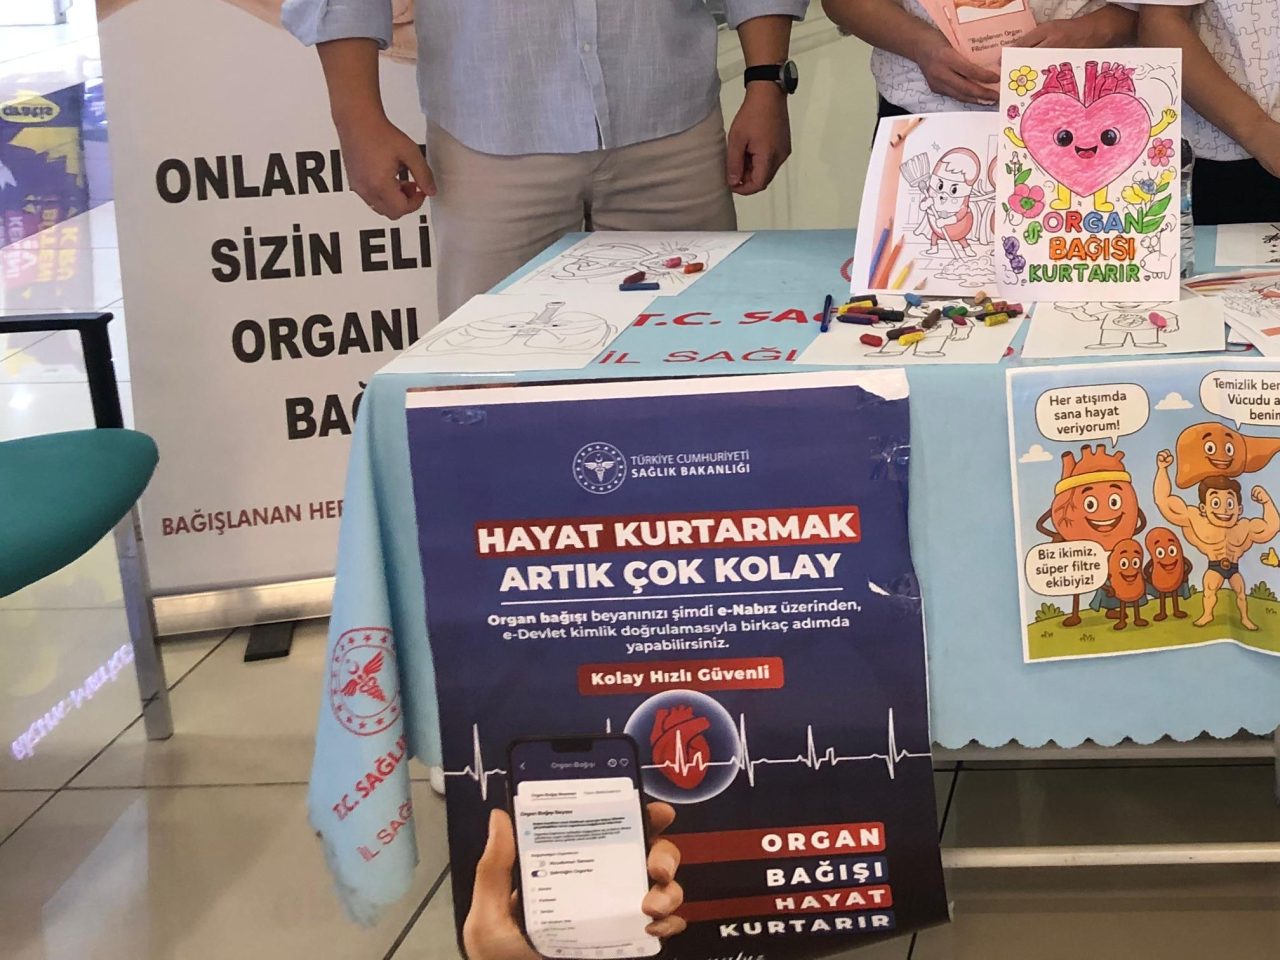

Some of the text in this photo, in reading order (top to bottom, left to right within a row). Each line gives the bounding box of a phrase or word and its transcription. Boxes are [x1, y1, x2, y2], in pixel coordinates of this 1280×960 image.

[155, 148, 347, 204] ONLARI
[1043, 206, 1144, 234] ORGAN
[211, 214, 432, 283] SİZİN ELİ
[1028, 263, 1140, 283] KURTARIR
[632, 311, 722, 328] T.C.
[1213, 377, 1258, 391] Temizlik
[1049, 390, 1127, 407] Her atışımda
[1227, 393, 1270, 406] Vücudu
[1054, 406, 1120, 422] sana hayat
[1056, 420, 1121, 438] veriyorum!
[630, 448, 750, 467] TÜRKİYE CUMHURİYETİ
[631, 461, 750, 479] SAĞLIK BAKANLIĞI
[161, 503, 302, 537] BAĞIŞLANAN
[477, 511, 857, 554] HAYAT KURTARMAK
[1038, 548, 1056, 561] Biz
[499, 552, 842, 595] ARTIK ÇOK KOLAY
[1036, 560, 1101, 579] süper filtre
[1045, 574, 1096, 591] ekibiyiz!
[487, 599, 862, 628] Organ bağışı beyanınızı şimdi e-Nabız üzerinden,
[502, 615, 850, 640] e-Devlet kimlik doğrulamasıyla birkaç adımda
[626, 636, 730, 655] yapabilirsiniz.
[591, 664, 770, 688] Kolay Hızlı Güvenli
[761, 827, 881, 853] ORGAN
[766, 860, 883, 887] BAĞIŞI
[774, 889, 886, 911] HAYAT
[719, 914, 890, 938] KURTARIR
